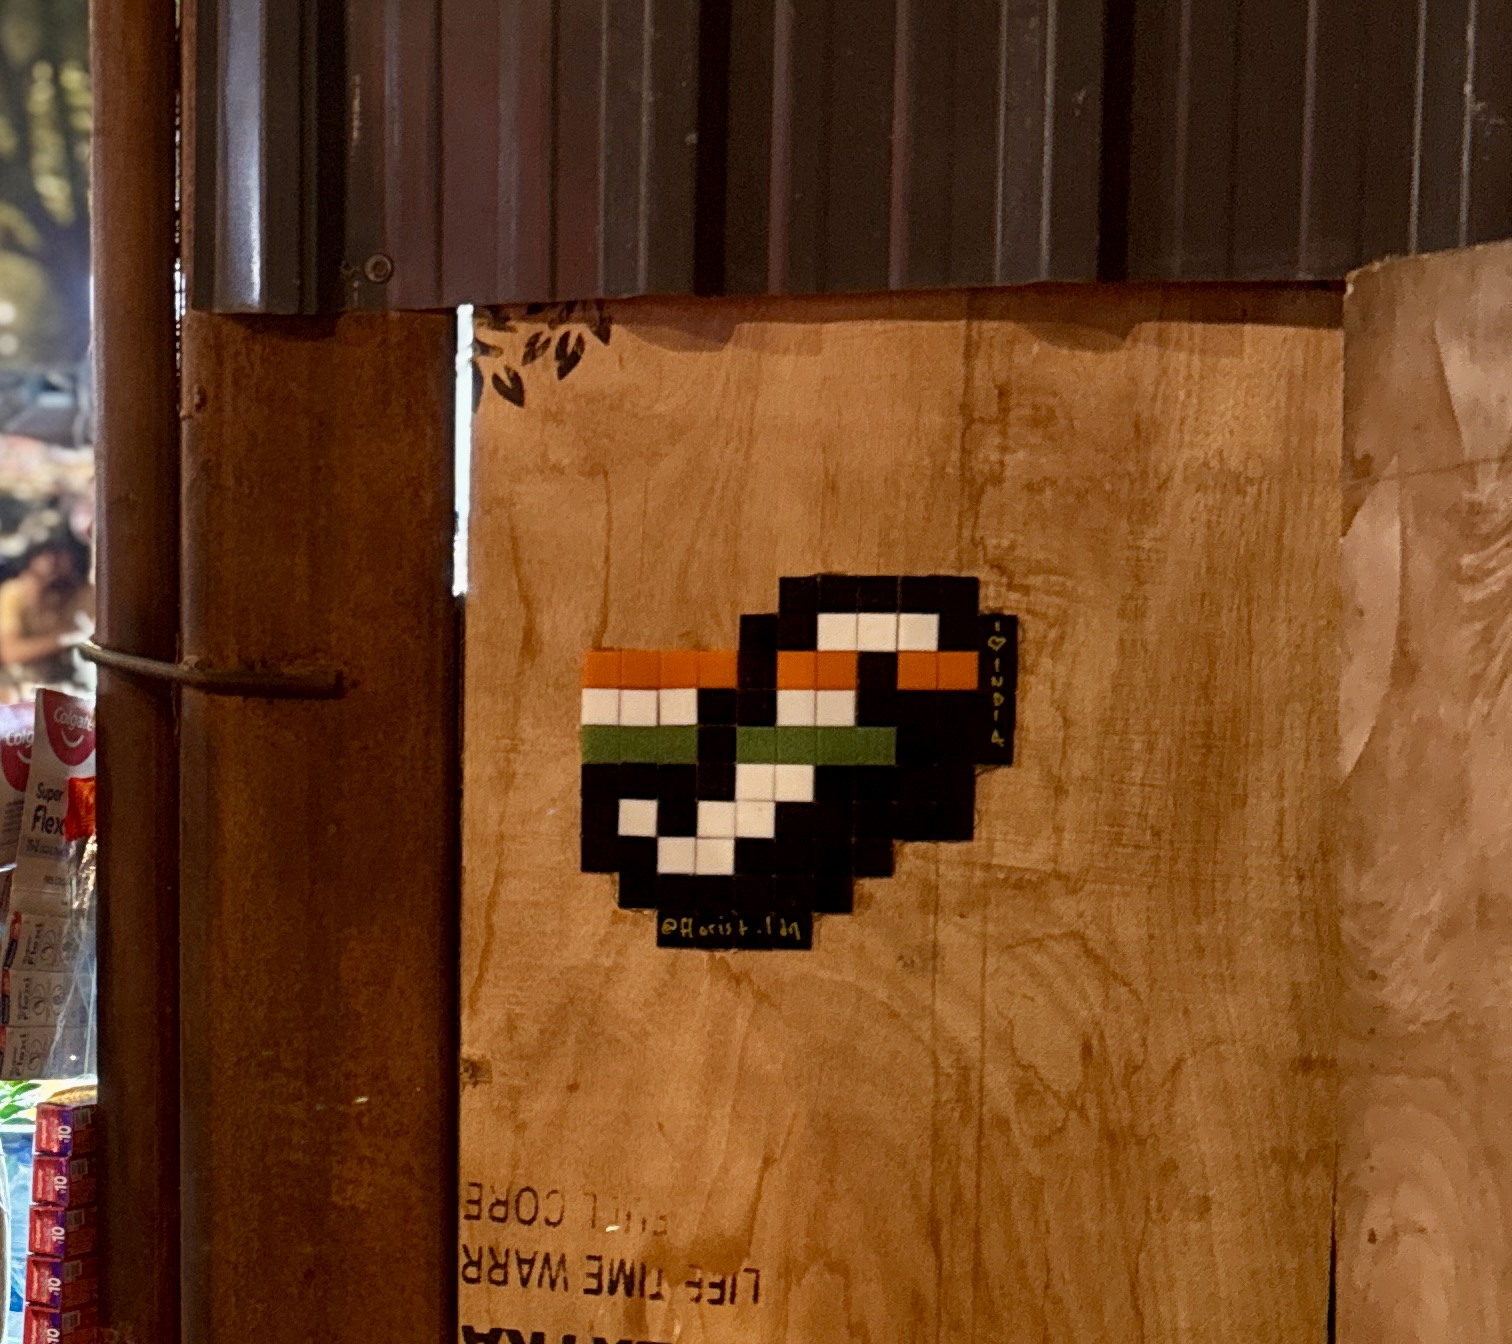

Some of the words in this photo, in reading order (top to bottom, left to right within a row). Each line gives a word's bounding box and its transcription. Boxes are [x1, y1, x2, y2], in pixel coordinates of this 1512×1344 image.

[990, 657, 1006, 748] INDIA
[6, 728, 35, 749] Colg
[31, 804, 66, 836] Flex
[463, 1181, 565, 1227] CORE
